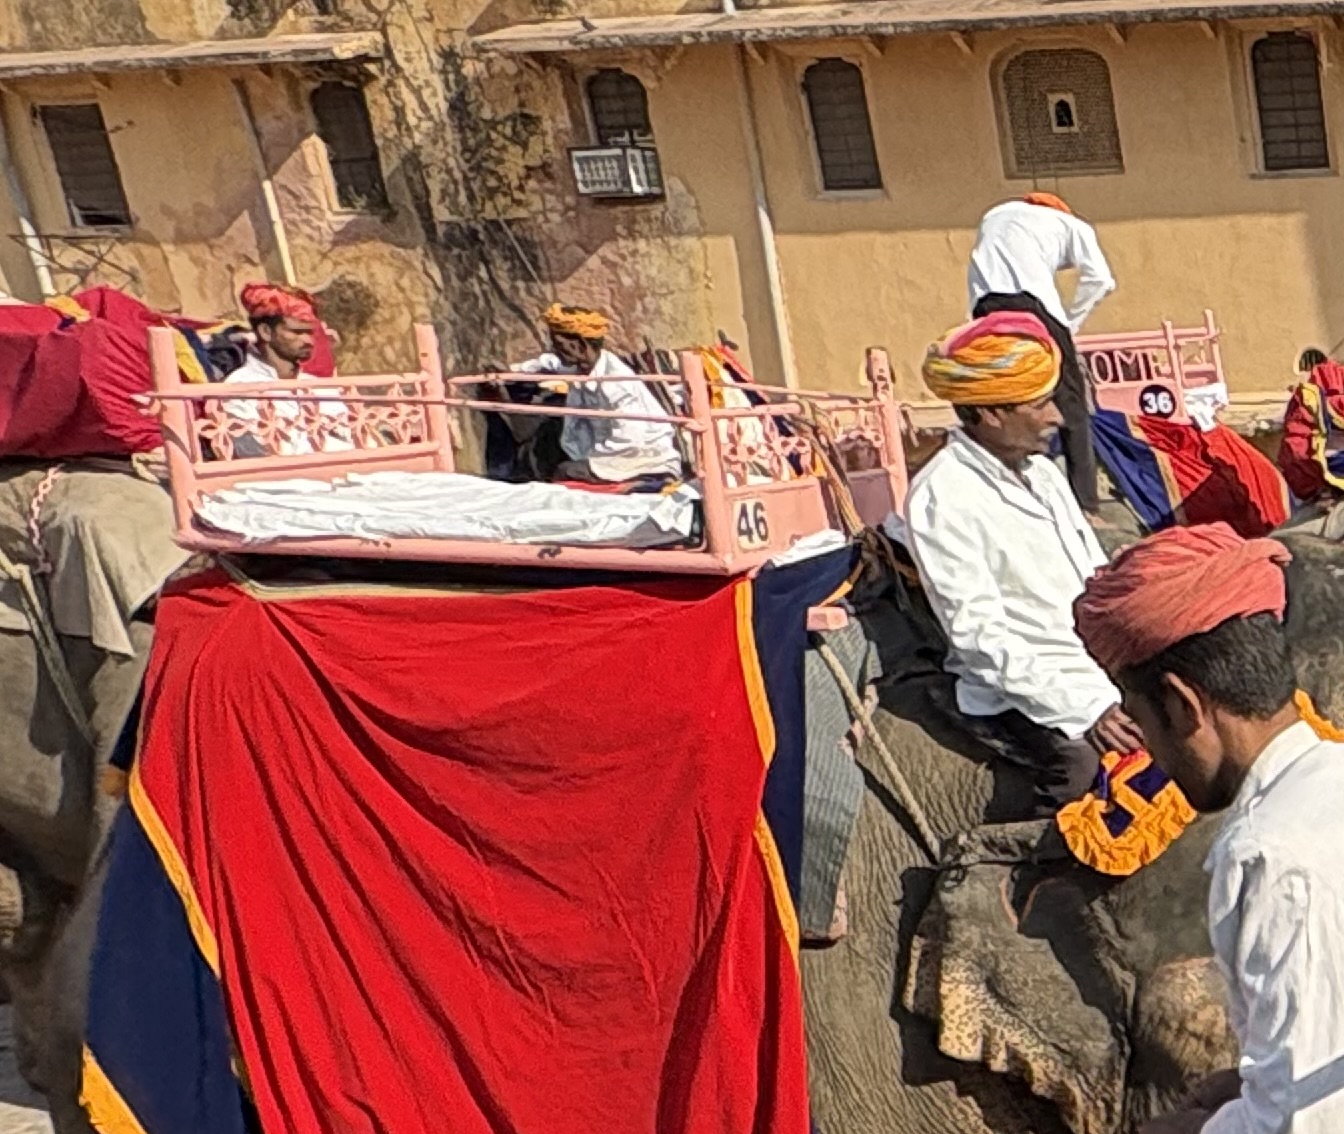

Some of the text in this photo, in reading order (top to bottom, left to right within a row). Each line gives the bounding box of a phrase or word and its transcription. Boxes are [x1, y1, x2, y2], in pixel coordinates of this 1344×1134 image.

[1090, 349, 1172, 384] OME
[1142, 392, 1174, 415] 36
[737, 501, 769, 543] 46
